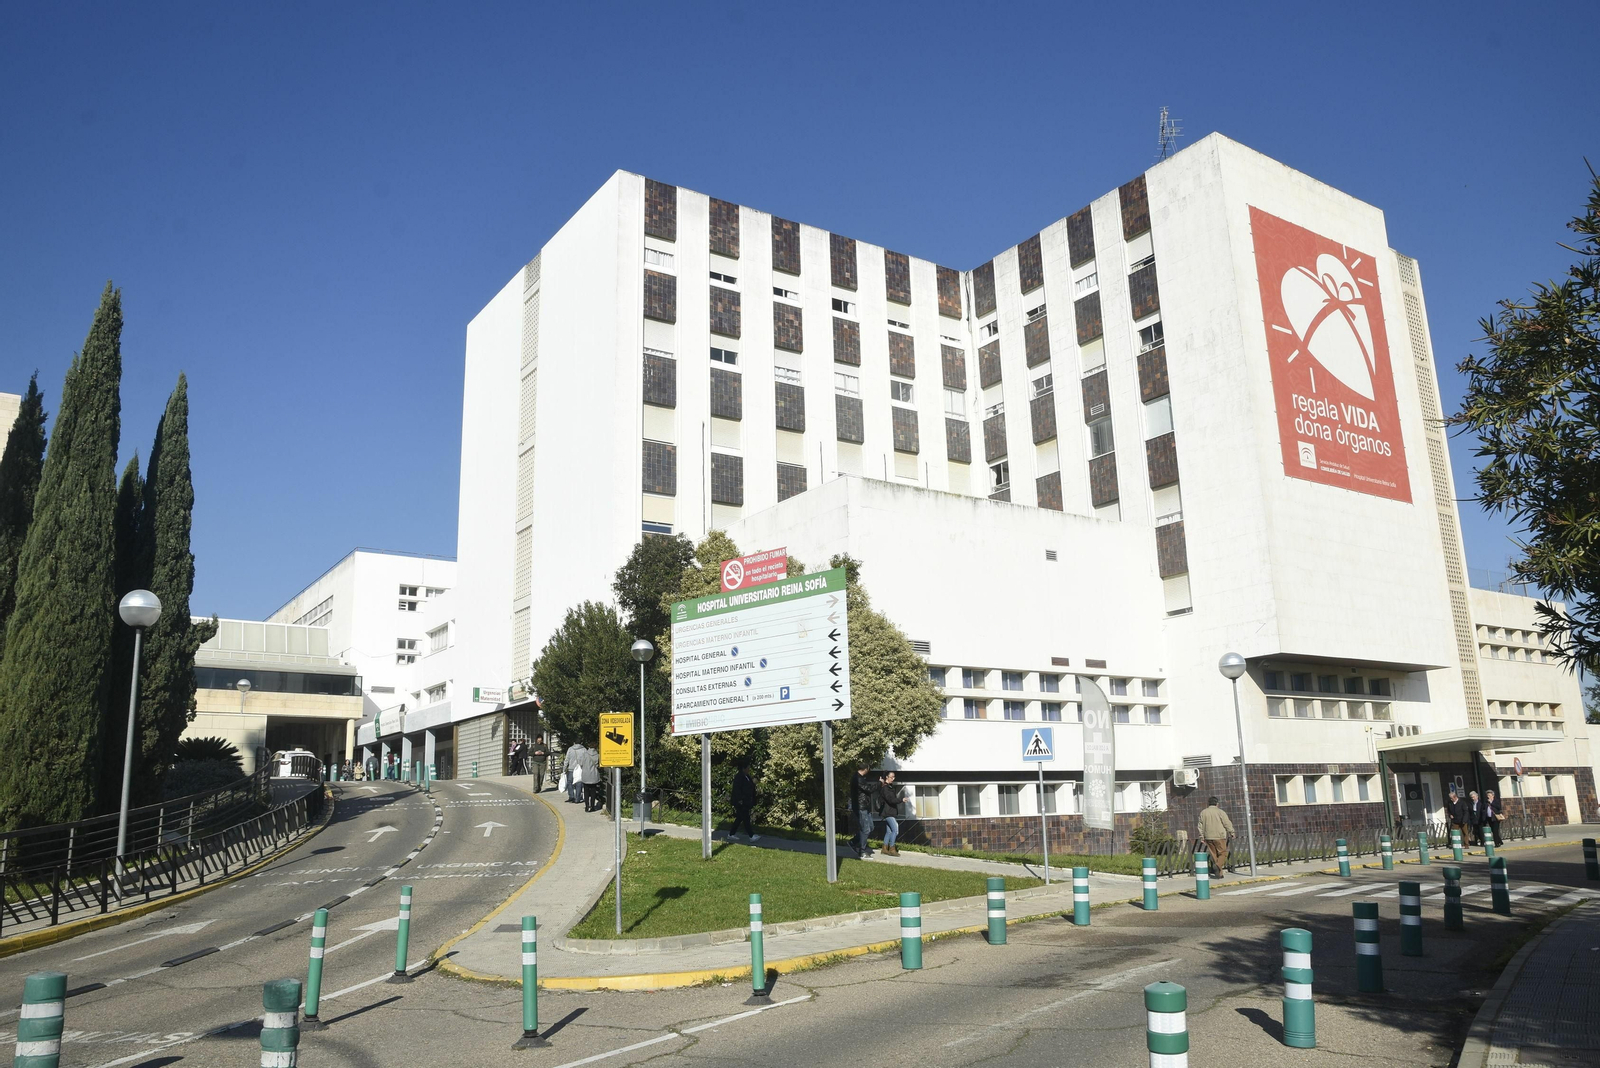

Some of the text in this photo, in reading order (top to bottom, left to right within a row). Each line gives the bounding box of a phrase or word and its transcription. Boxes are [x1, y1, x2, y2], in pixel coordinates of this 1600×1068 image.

[1292, 393, 1380, 433] regala VIDA
[1294, 413, 1392, 456] dona órganos
[743, 549, 787, 565] PROHIBIDO FUMAR
[751, 571, 777, 582] hospitalario
[752, 566, 762, 574] todo
[768, 562, 784, 570] recinto
[697, 575, 827, 613] HOSPITAL UNIVERSITARIO REINA SOFÍA
[675, 616, 739, 634] URGENCIAS GENERALES
[675, 628, 759, 649] URGENCIAS MATERNO INFANTIL
[675, 650, 727, 665] HOSPITAL GENERAL
[675, 661, 755, 680] HOSPITAL MATERNO INFANTIL
[675, 680, 737, 695] CONSULTAS EXTERNAS
[676, 698, 717, 710] APARCAMIENTO
[718, 695, 744, 705] GENERAL
